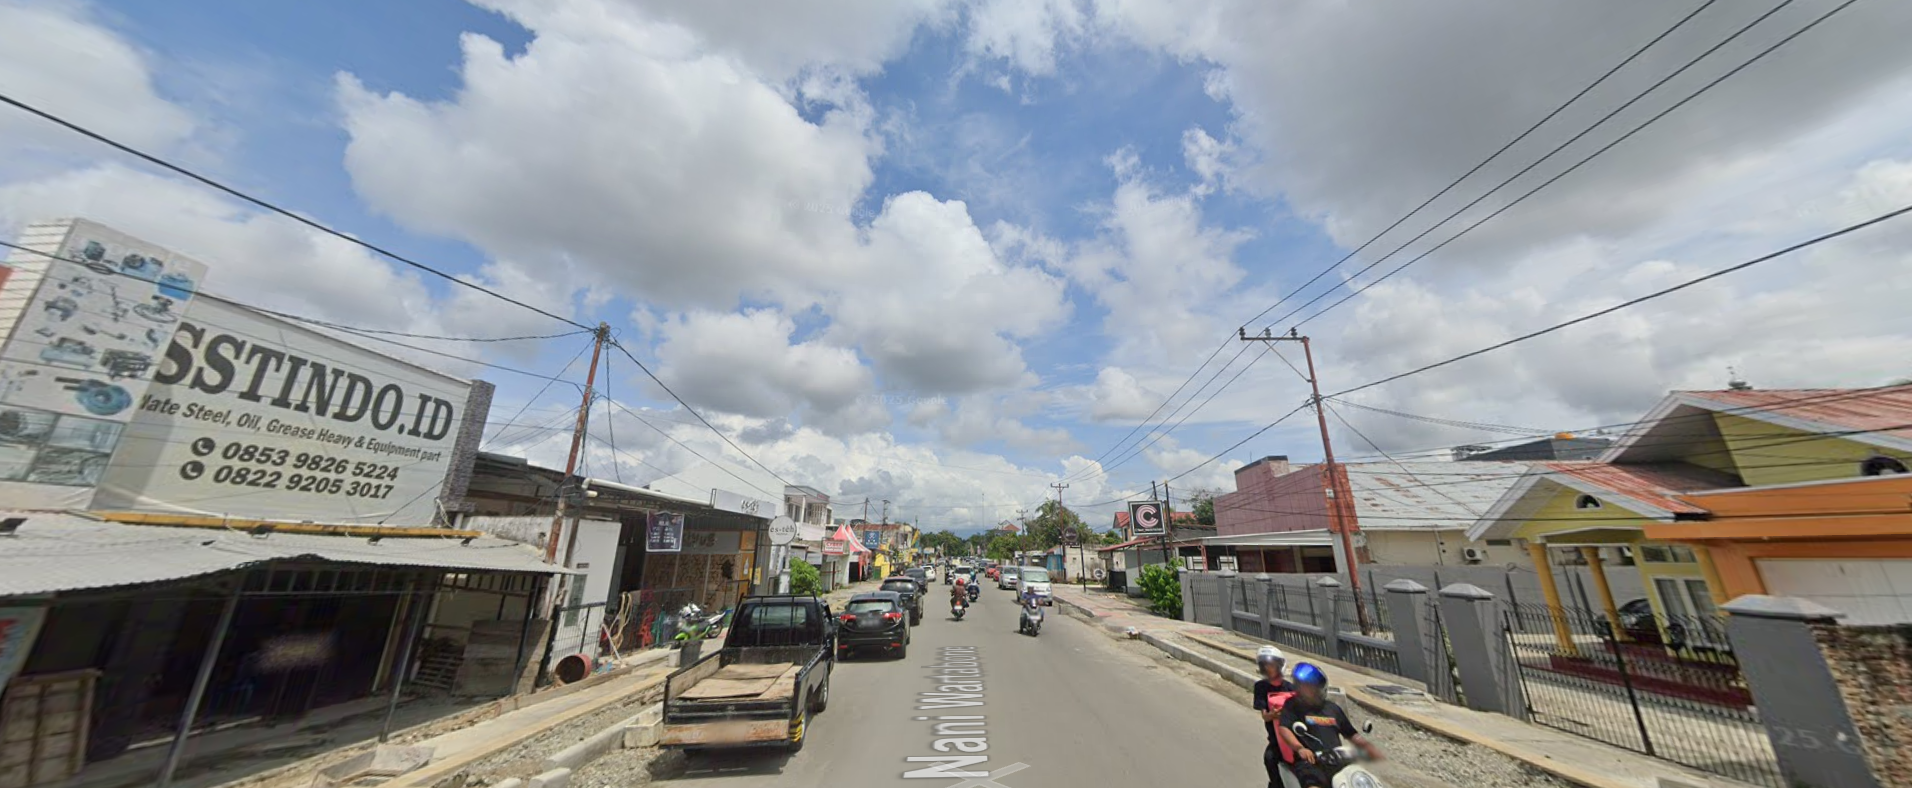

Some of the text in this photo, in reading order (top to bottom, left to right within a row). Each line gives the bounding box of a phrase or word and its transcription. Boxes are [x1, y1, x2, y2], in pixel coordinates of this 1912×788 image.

[139, 394, 442, 463] late Steel, Oil, Grease Heavy & Equipment part
[221, 441, 400, 482] 0853 9826 5224
[212, 465, 395, 500] 0822 9205 3017
